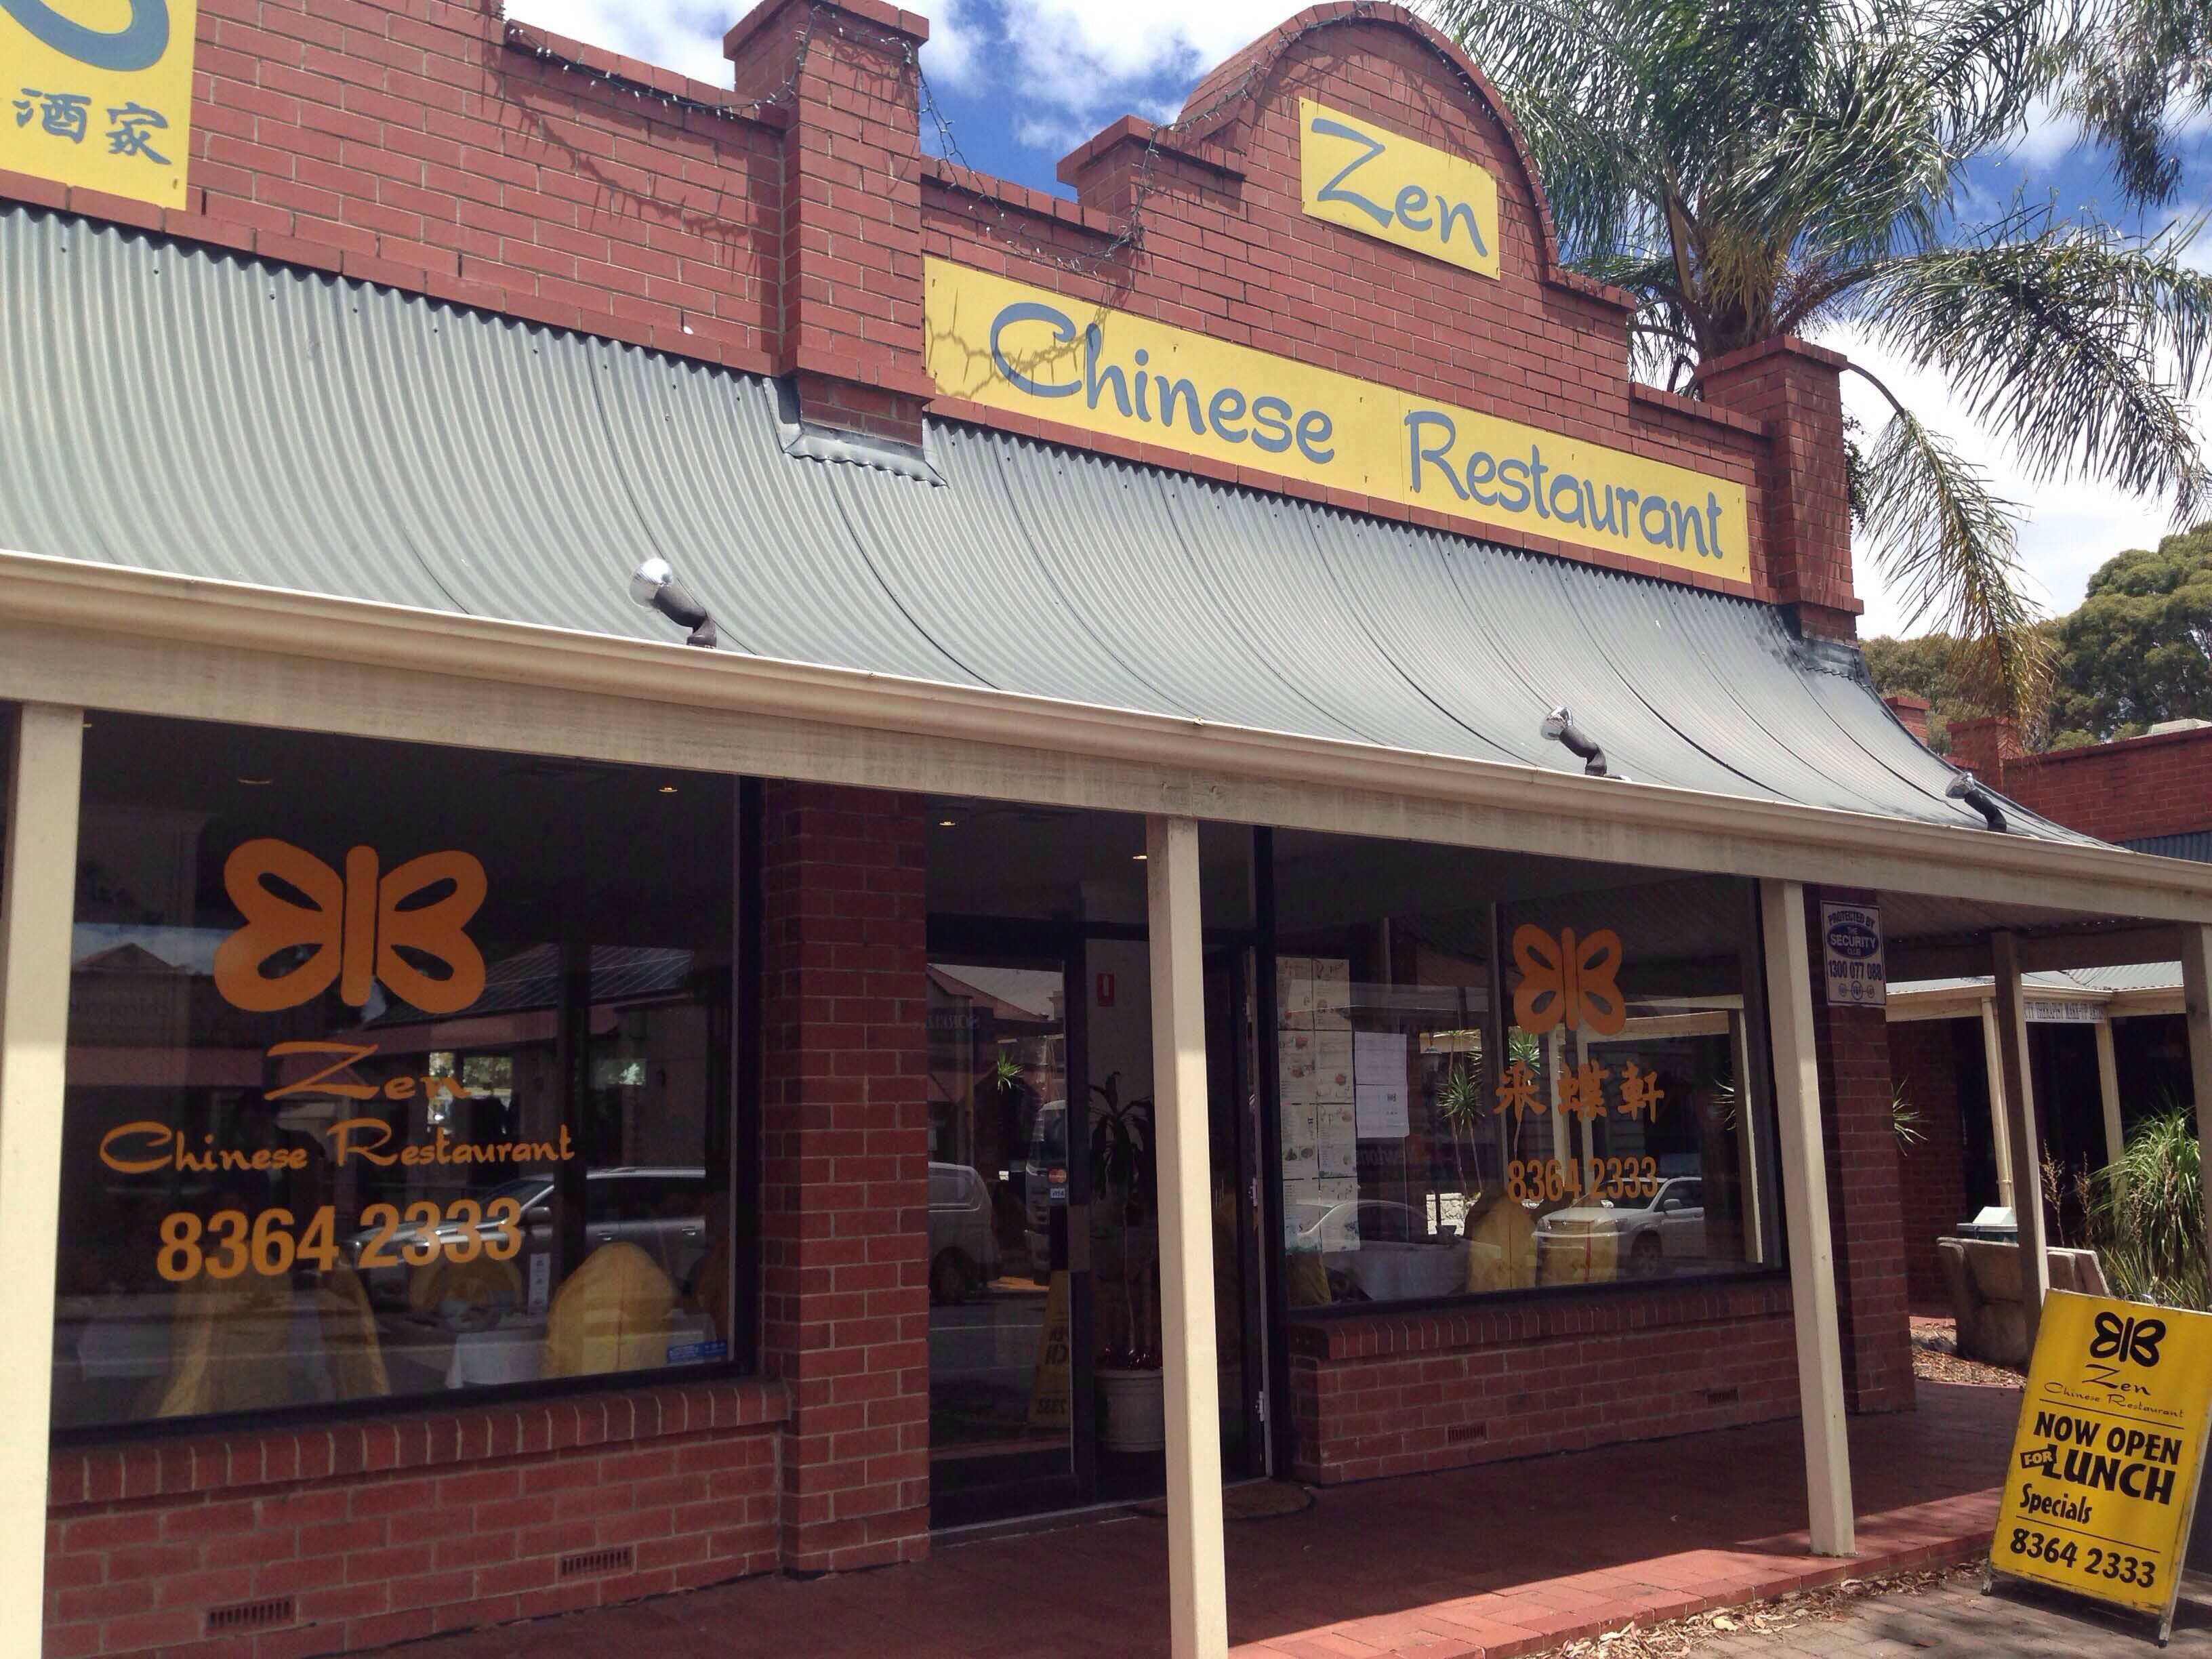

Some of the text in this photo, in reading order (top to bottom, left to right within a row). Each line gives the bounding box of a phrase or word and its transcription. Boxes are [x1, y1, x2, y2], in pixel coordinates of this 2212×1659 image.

[12, 87, 172, 165] 酒家
[1310, 117, 1488, 258] Zen
[989, 302, 1723, 559] Chinese Restaurant
[1827, 910, 1864, 926] PROTECTED
[1829, 933, 1876, 949] SECURITY
[1828, 959, 1848, 978] 1300
[264, 1041, 472, 1101] Zen
[99, 1118, 575, 1174] Chinese Restaurant
[1507, 1155, 1658, 1204] 8364 2333
[157, 1197, 523, 1282] 8364 2333
[2044, 1382, 2184, 1418] Chinese Restaurant
[2082, 1364, 2151, 1396] Zen
[2033, 1411, 2183, 1465] NOW OPEN
[2024, 1443, 2176, 1506] FOR LUNCH
[2020, 1482, 2093, 1525] Specials
[2010, 1528, 2156, 1589] 8364 2333
